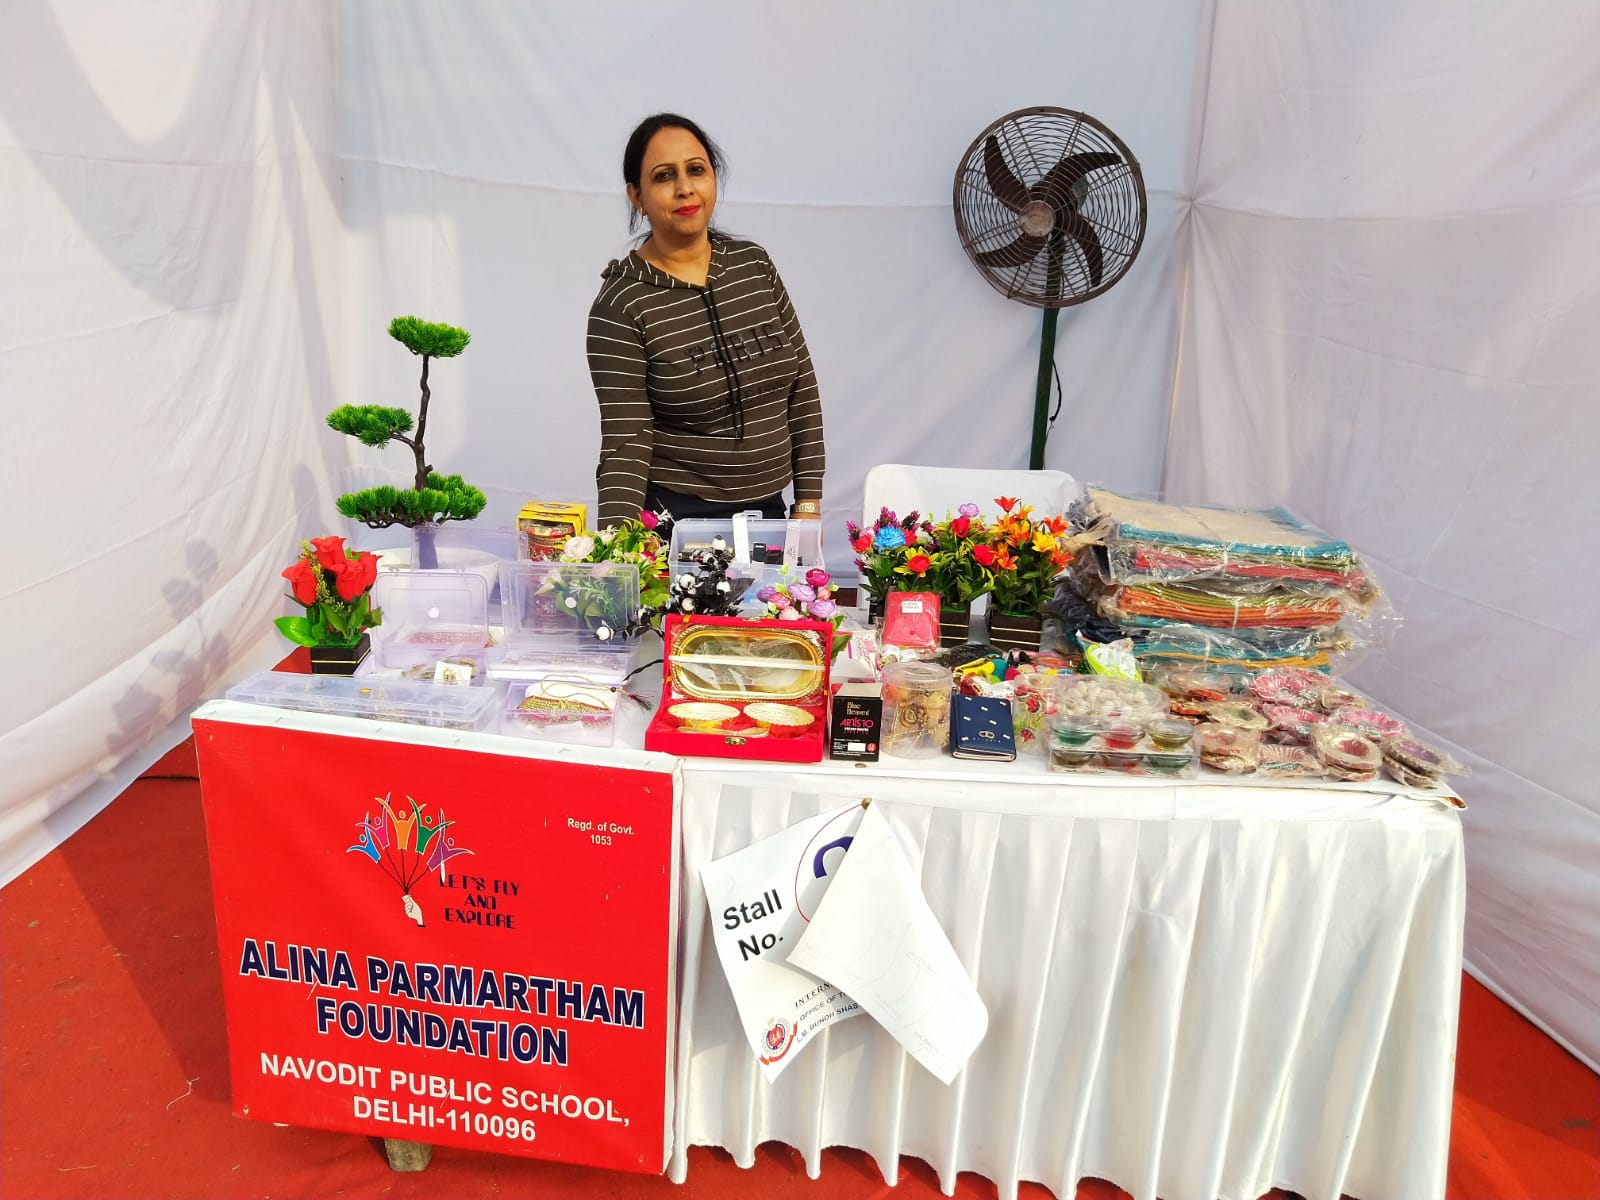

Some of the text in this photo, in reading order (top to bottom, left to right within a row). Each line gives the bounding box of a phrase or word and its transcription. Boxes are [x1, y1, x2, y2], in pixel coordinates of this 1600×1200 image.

[567, 817, 635, 835] Regd. of Govt.
[590, 834, 612, 846] 1053
[464, 893, 496, 910] AND
[723, 889, 783, 930] Stall
[444, 907, 517, 929] EXPLORE
[737, 933, 784, 961] No.
[240, 938, 645, 1029] ALINA PARMARTHAM
[794, 981, 833, 1009] INTERN
[836, 1001, 863, 1016] SHAS
[316, 997, 569, 1067] FOUNDATION
[260, 1053, 630, 1127] NAVODIT PUBLIC SCHOOL,
[352, 1096, 536, 1143] DELHI-110096
